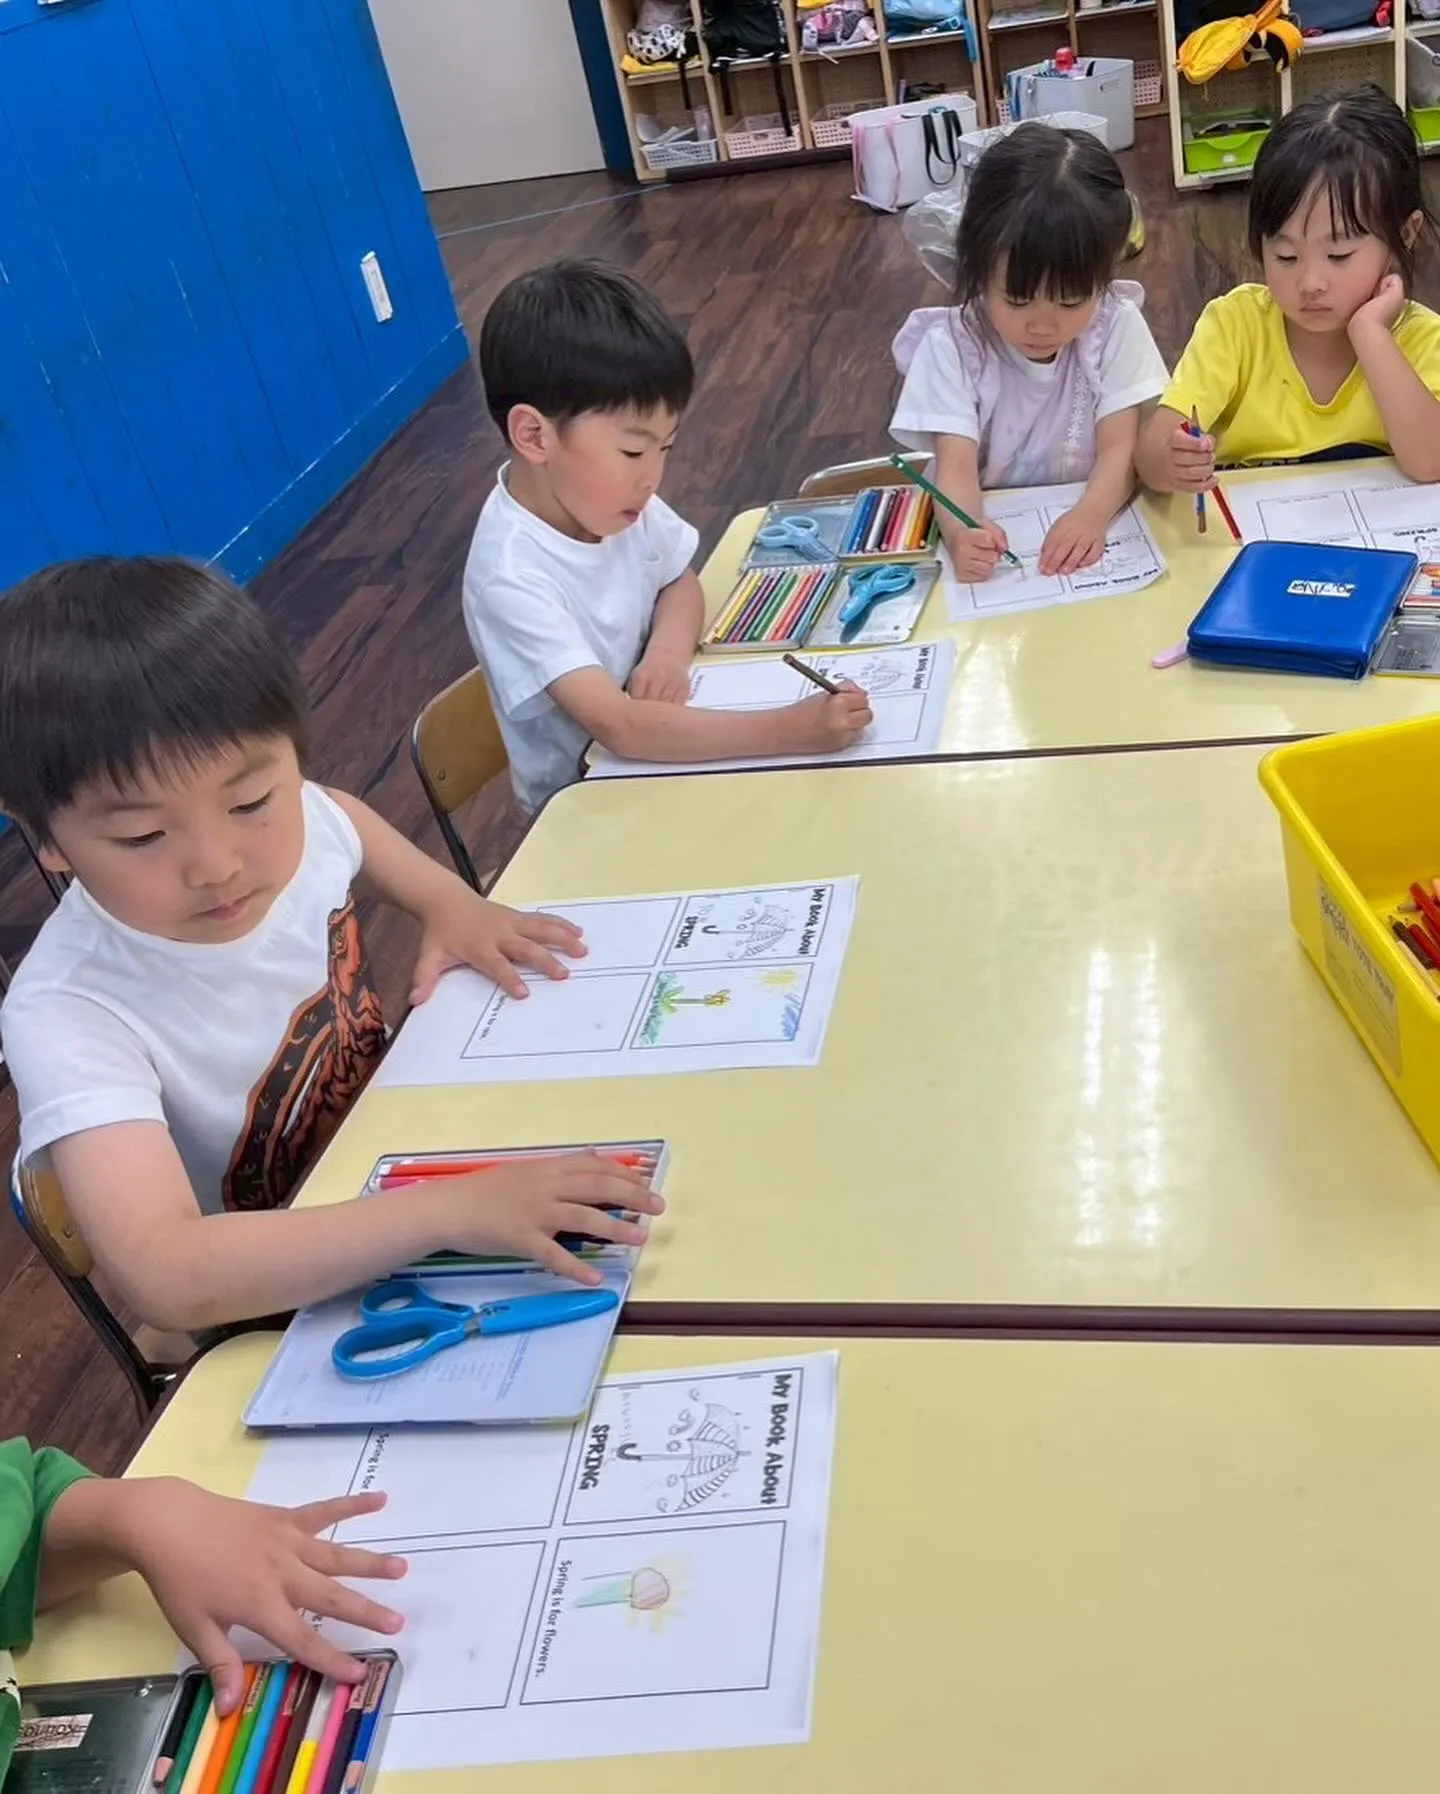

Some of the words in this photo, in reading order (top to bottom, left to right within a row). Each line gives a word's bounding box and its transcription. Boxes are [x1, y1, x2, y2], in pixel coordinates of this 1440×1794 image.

[804, 904, 822, 927] Book
[798, 929, 816, 954] About
[771, 1373, 792, 1399] My
[765, 1403, 789, 1447] Book
[578, 1424, 610, 1491] SPRING
[760, 1452, 785, 1505] About
[551, 1559, 572, 1596] Spring
[547, 1609, 562, 1626] for
[551, 1597, 565, 1608] is
[535, 1629, 558, 1678] flowers.
